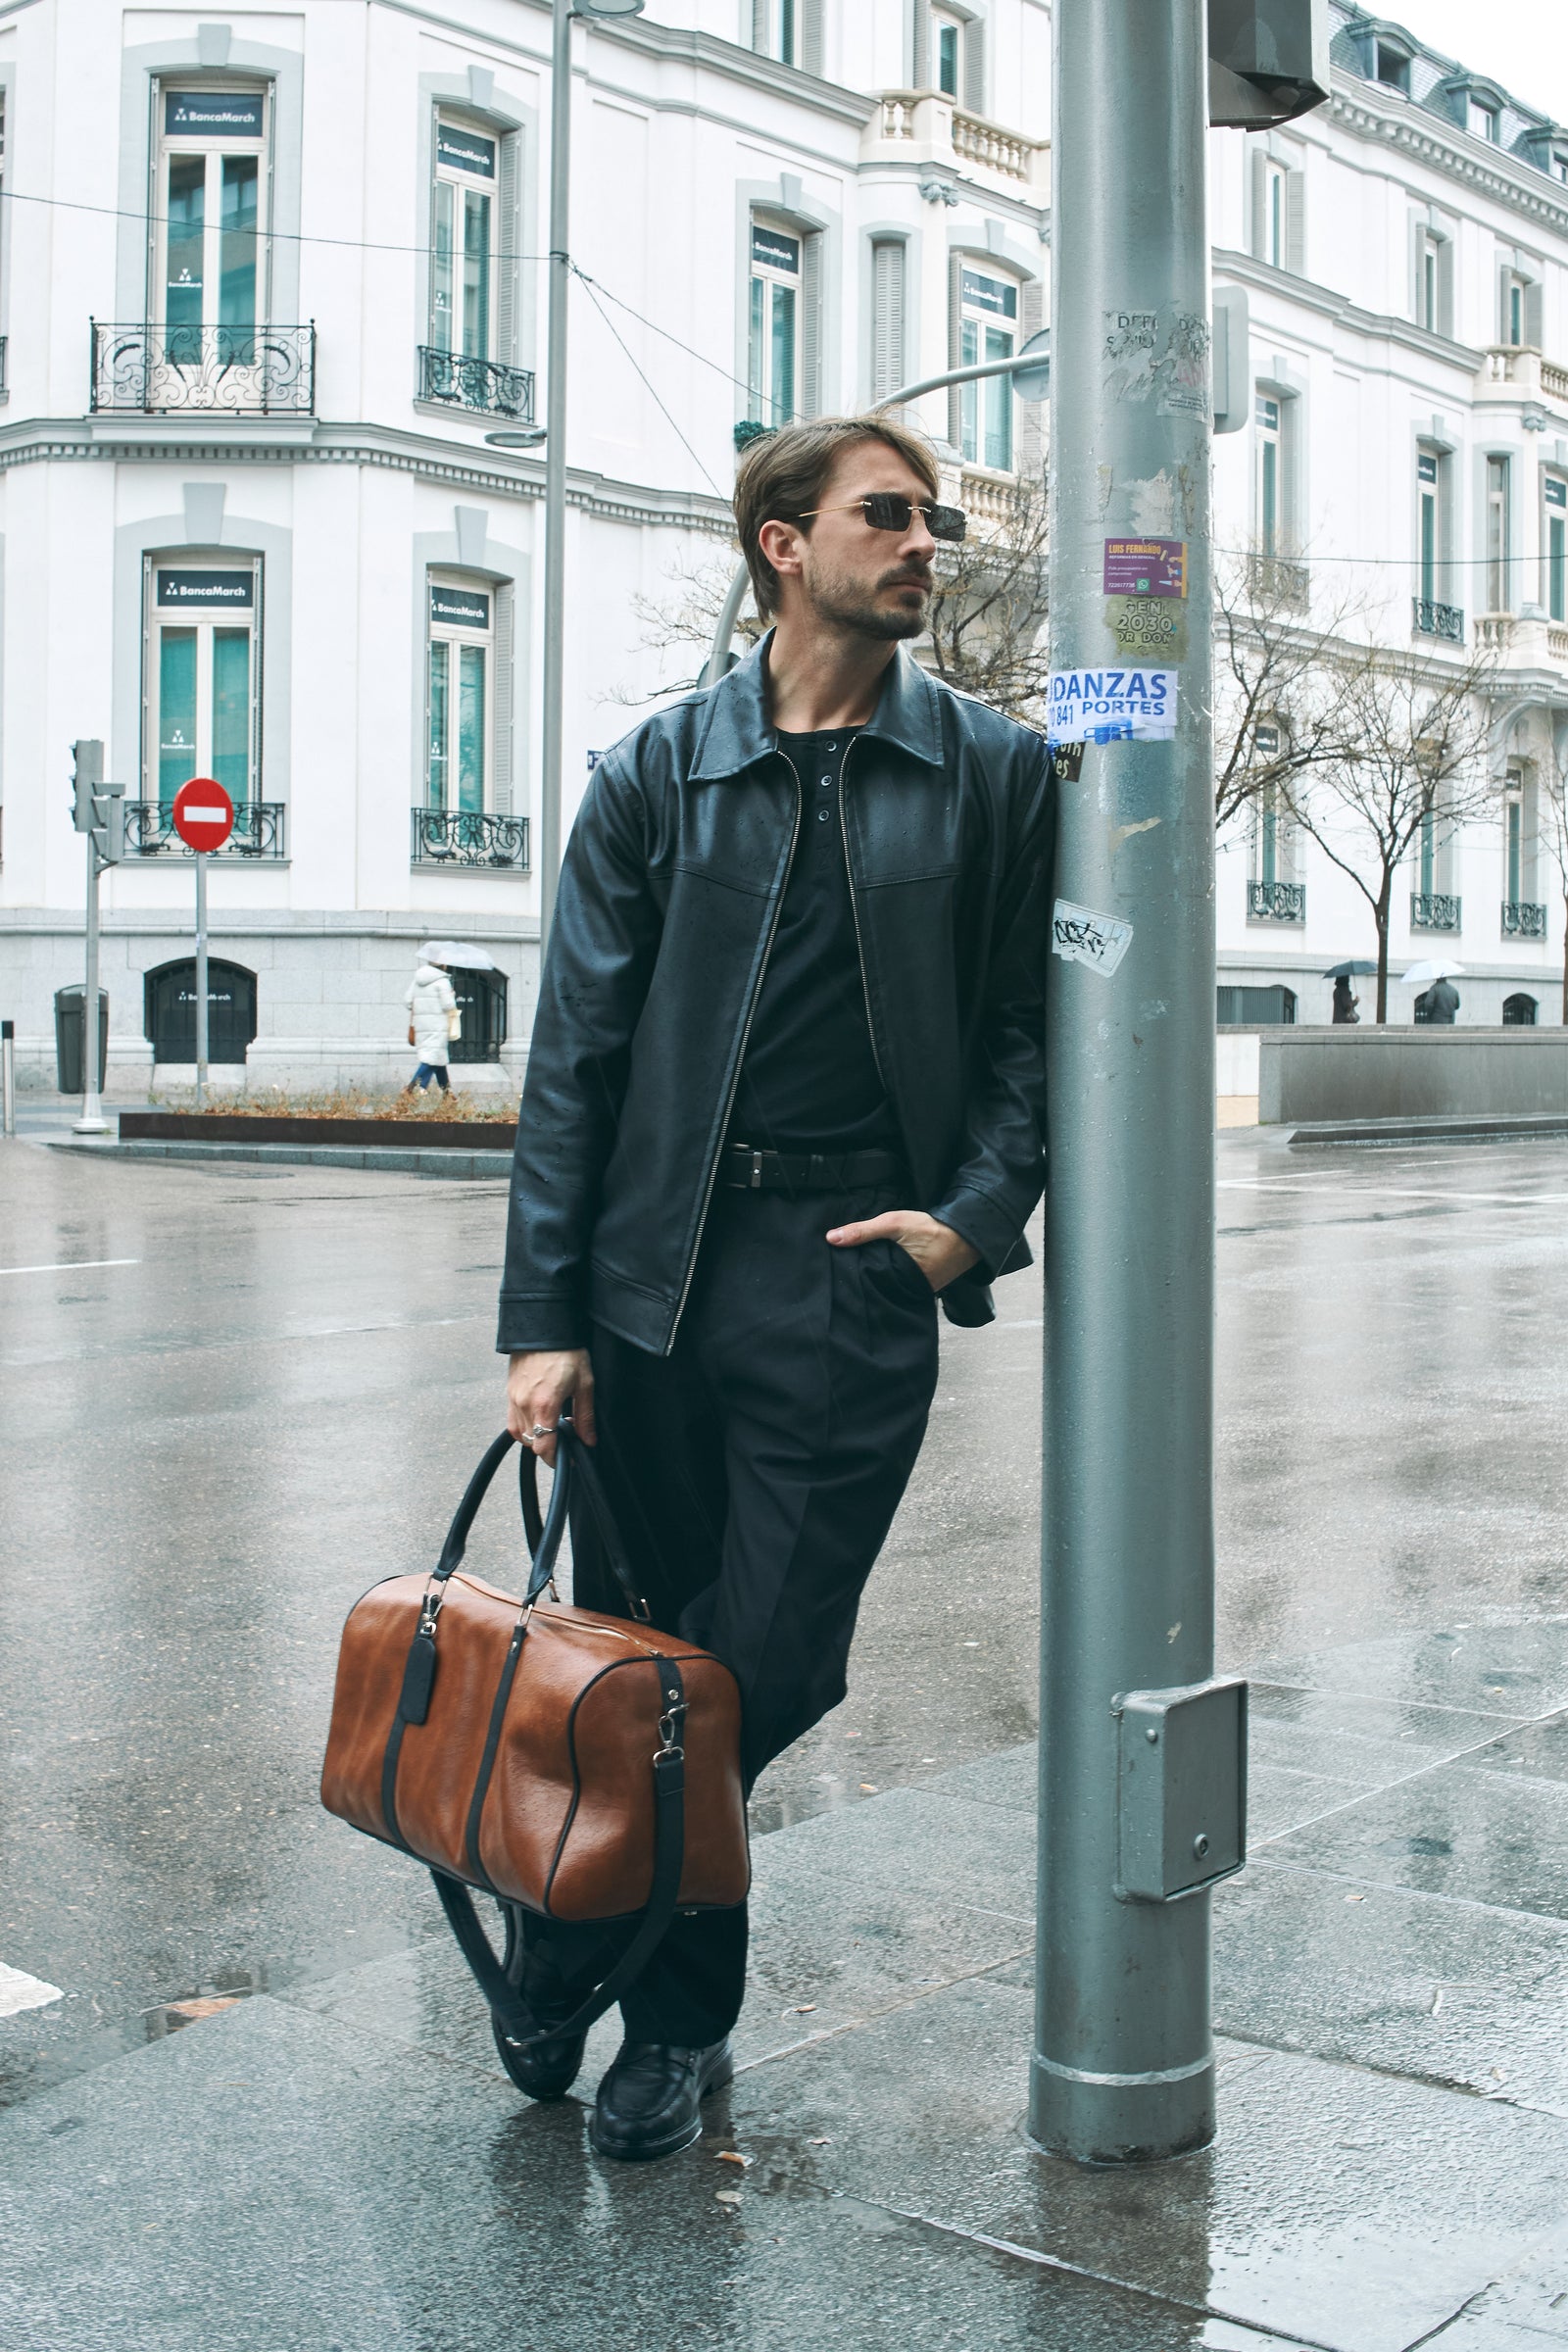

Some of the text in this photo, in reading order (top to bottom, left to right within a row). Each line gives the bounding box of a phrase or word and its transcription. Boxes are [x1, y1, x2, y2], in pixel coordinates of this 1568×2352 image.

[189, 112, 255, 122] BancaMarch
[443, 142, 490, 165] BancaMarch
[1108, 544, 1125, 554] LUIS
[179, 586, 246, 597] BancaMarch
[437, 603, 485, 618] BancaMarch
[1115, 614, 1173, 633] 2030
[1082, 701, 1165, 715] PORTES
